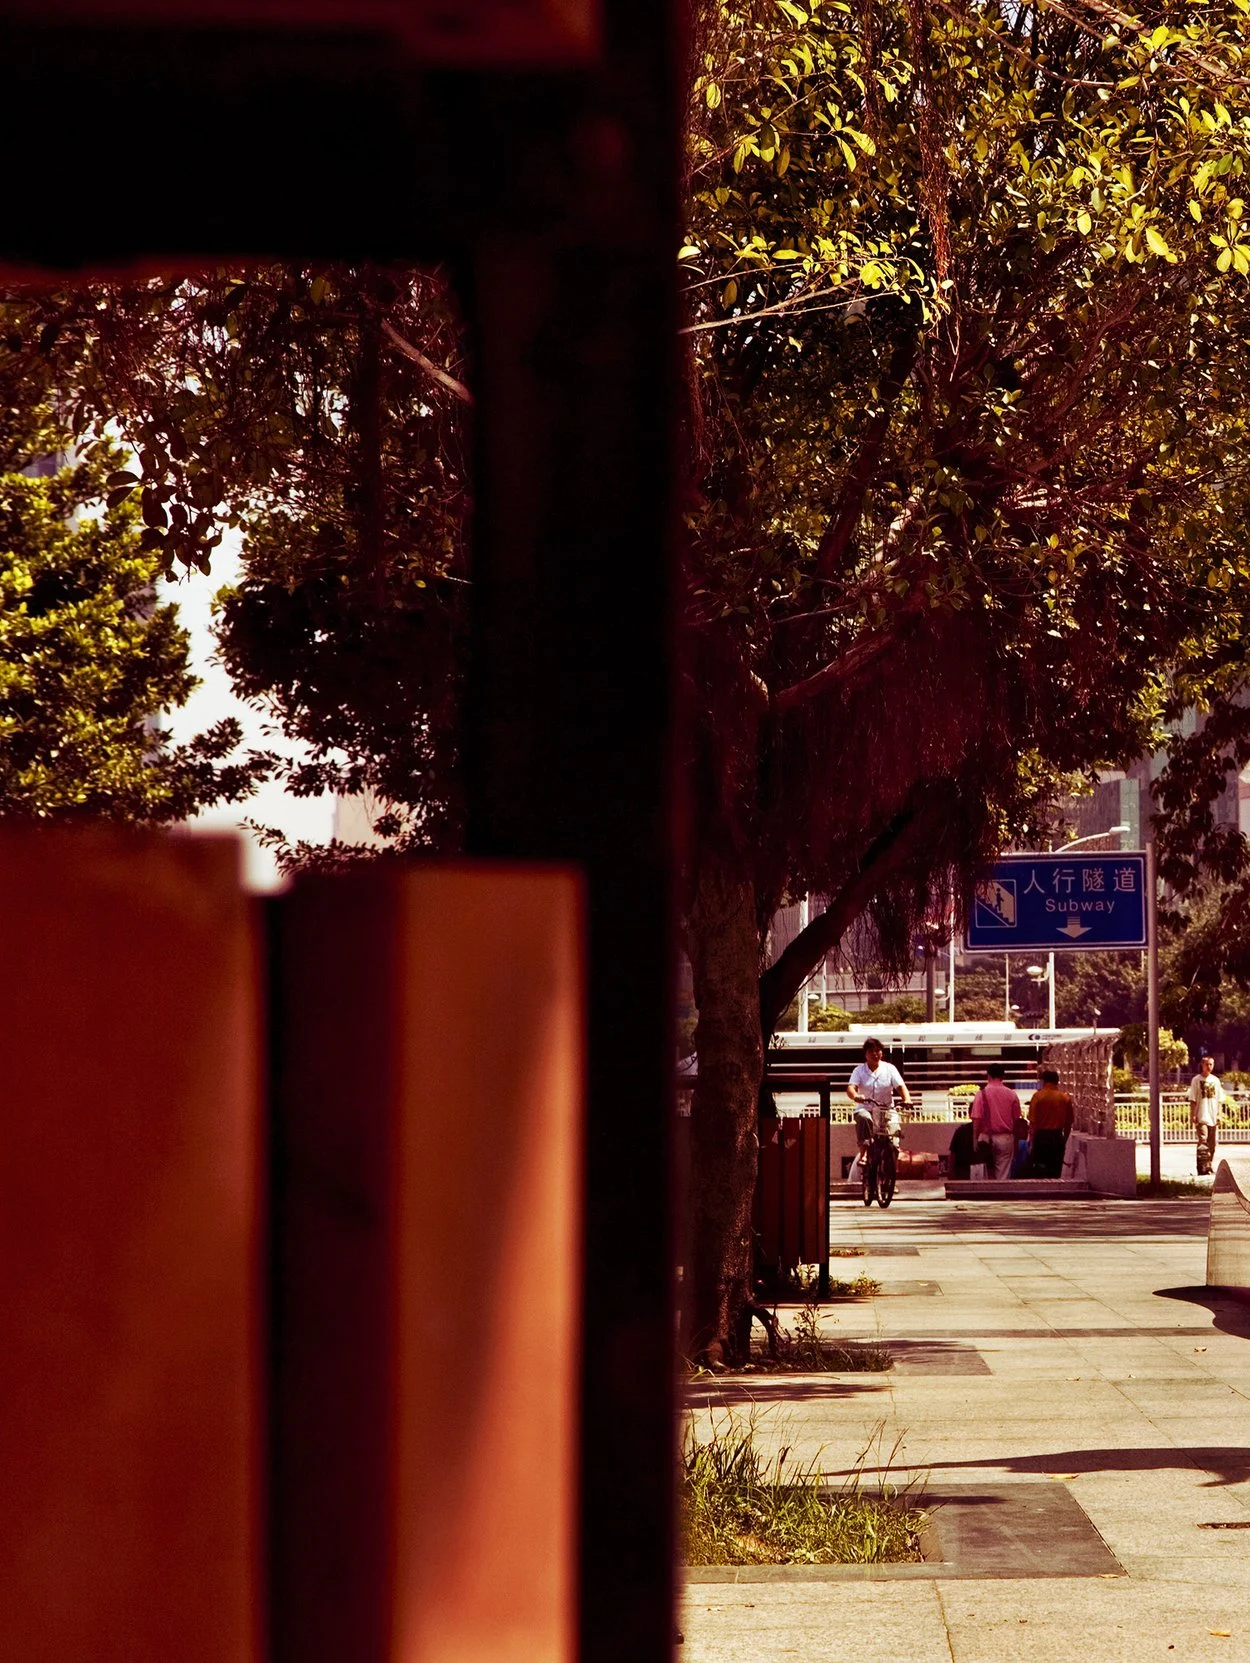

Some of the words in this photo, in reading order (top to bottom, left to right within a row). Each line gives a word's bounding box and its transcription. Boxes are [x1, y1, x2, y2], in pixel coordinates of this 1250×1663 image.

[1023, 867, 1136, 894] 人行隧道
[1045, 898, 1115, 914] Subway
